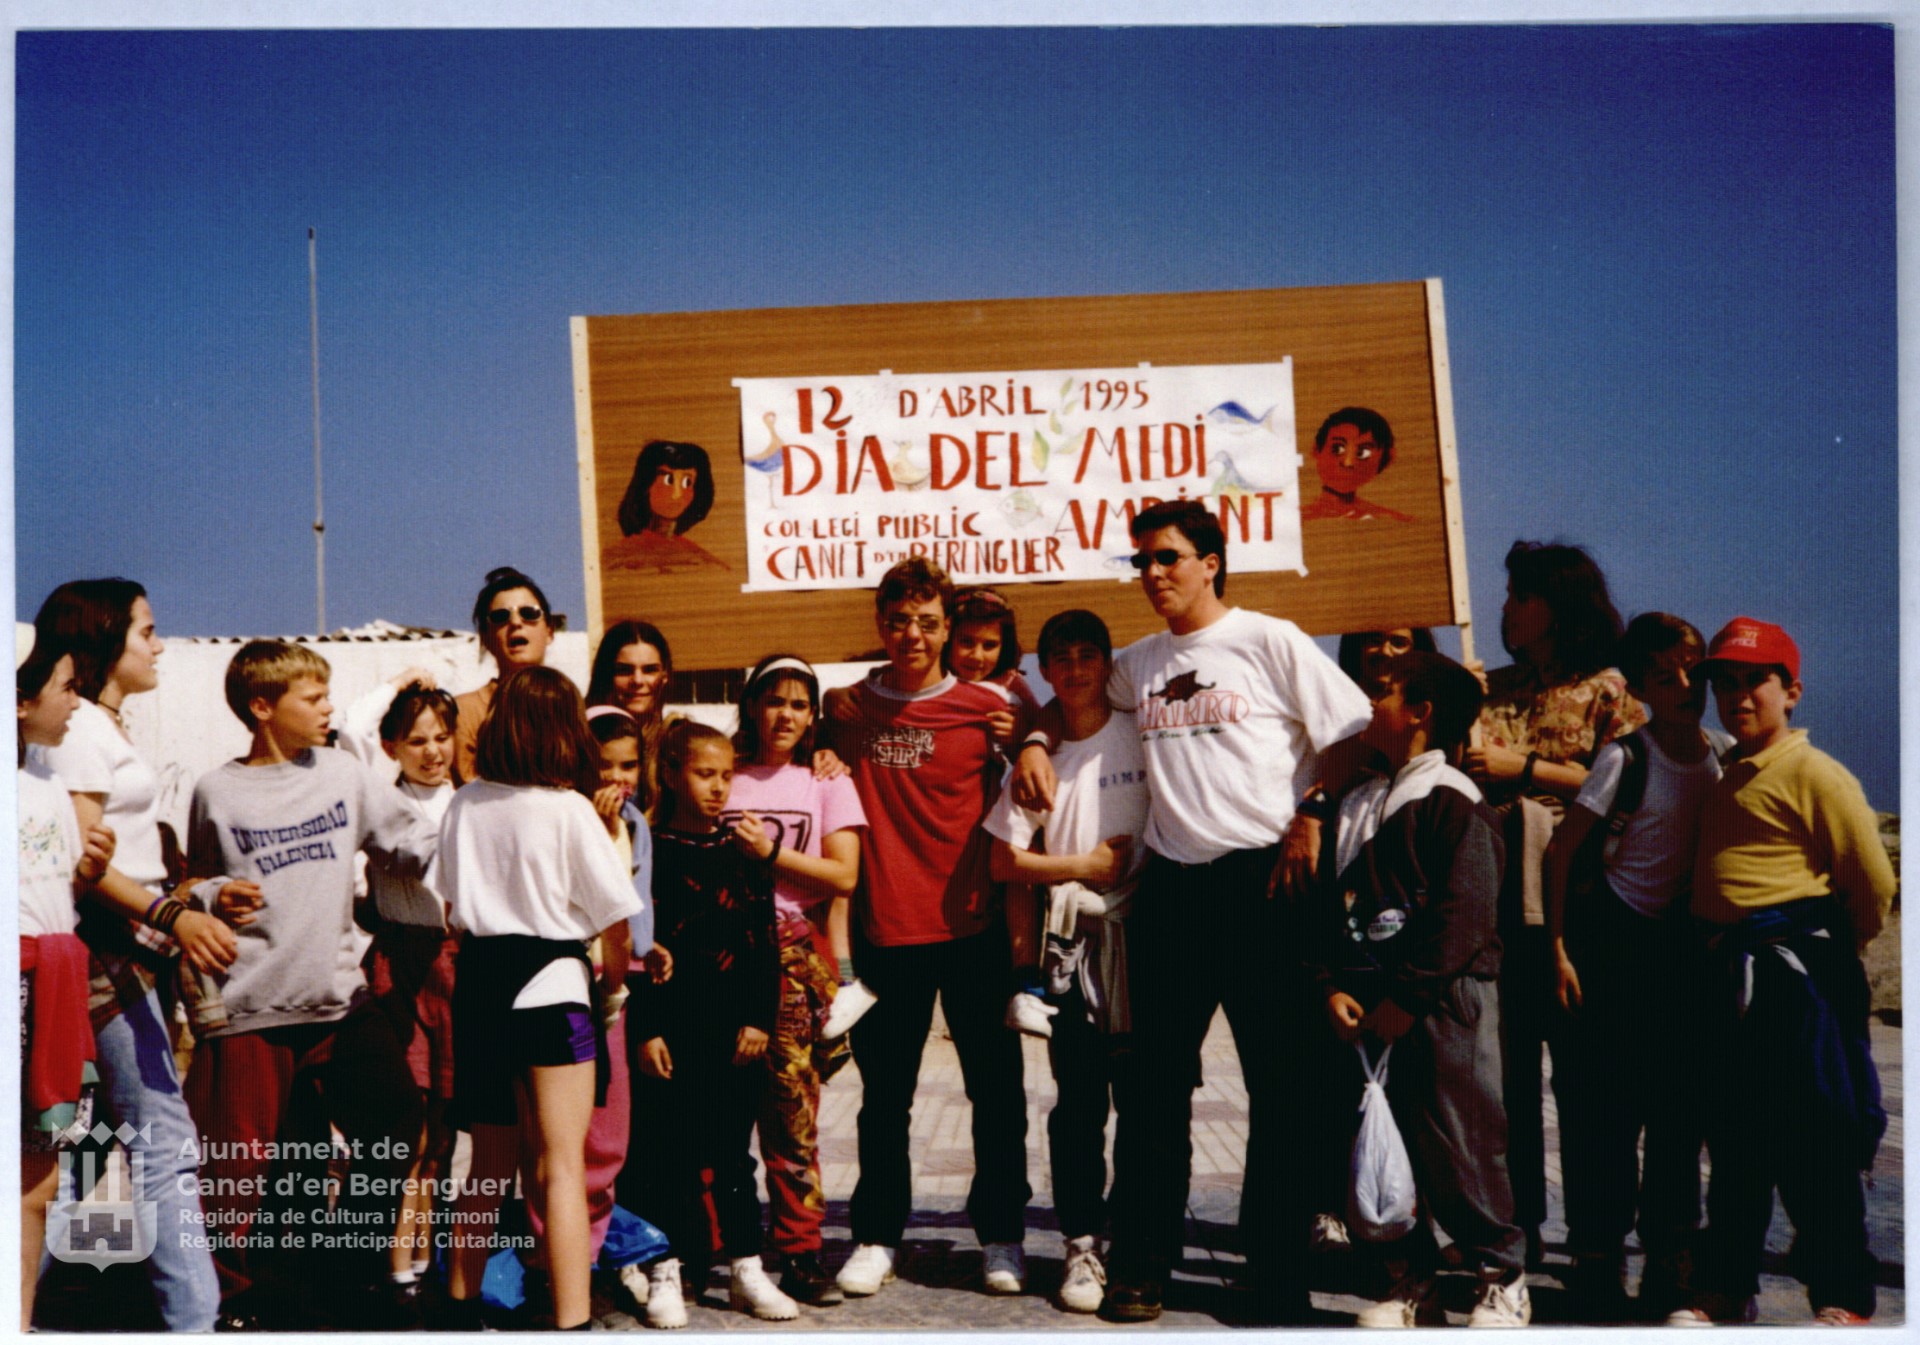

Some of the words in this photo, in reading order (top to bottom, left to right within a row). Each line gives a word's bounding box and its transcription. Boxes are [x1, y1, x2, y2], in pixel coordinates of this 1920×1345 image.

[797, 386, 853, 433] 12
[1081, 379, 1149, 411] 1995
[929, 430, 1048, 491] DEL
[229, 800, 348, 855] UNIVERSIDAD
[255, 841, 337, 876] VALENCIA
